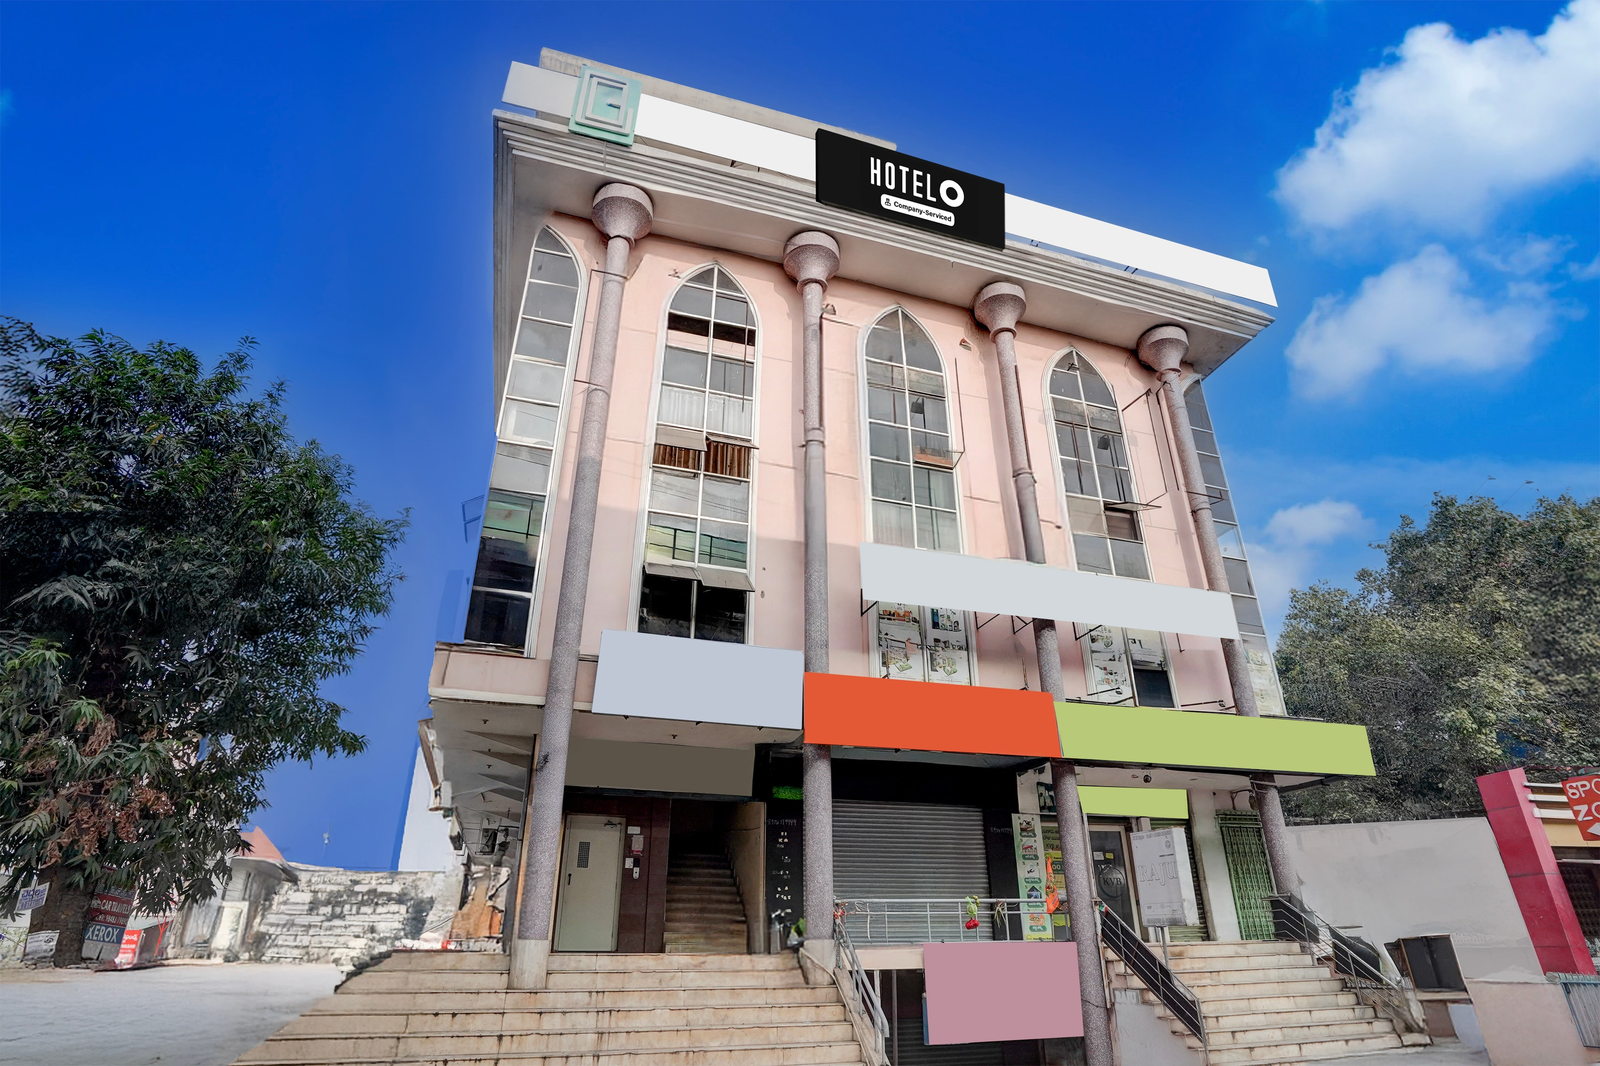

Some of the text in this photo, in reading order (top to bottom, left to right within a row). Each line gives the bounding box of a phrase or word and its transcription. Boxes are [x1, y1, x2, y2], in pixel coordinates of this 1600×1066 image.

[893, 200, 952, 222] Company-Serviced
[1103, 877, 1122, 886] KVB
[1137, 861, 1179, 887] RAJU
[100, 899, 112, 911] CAR
[85, 925, 120, 943] XEROX
